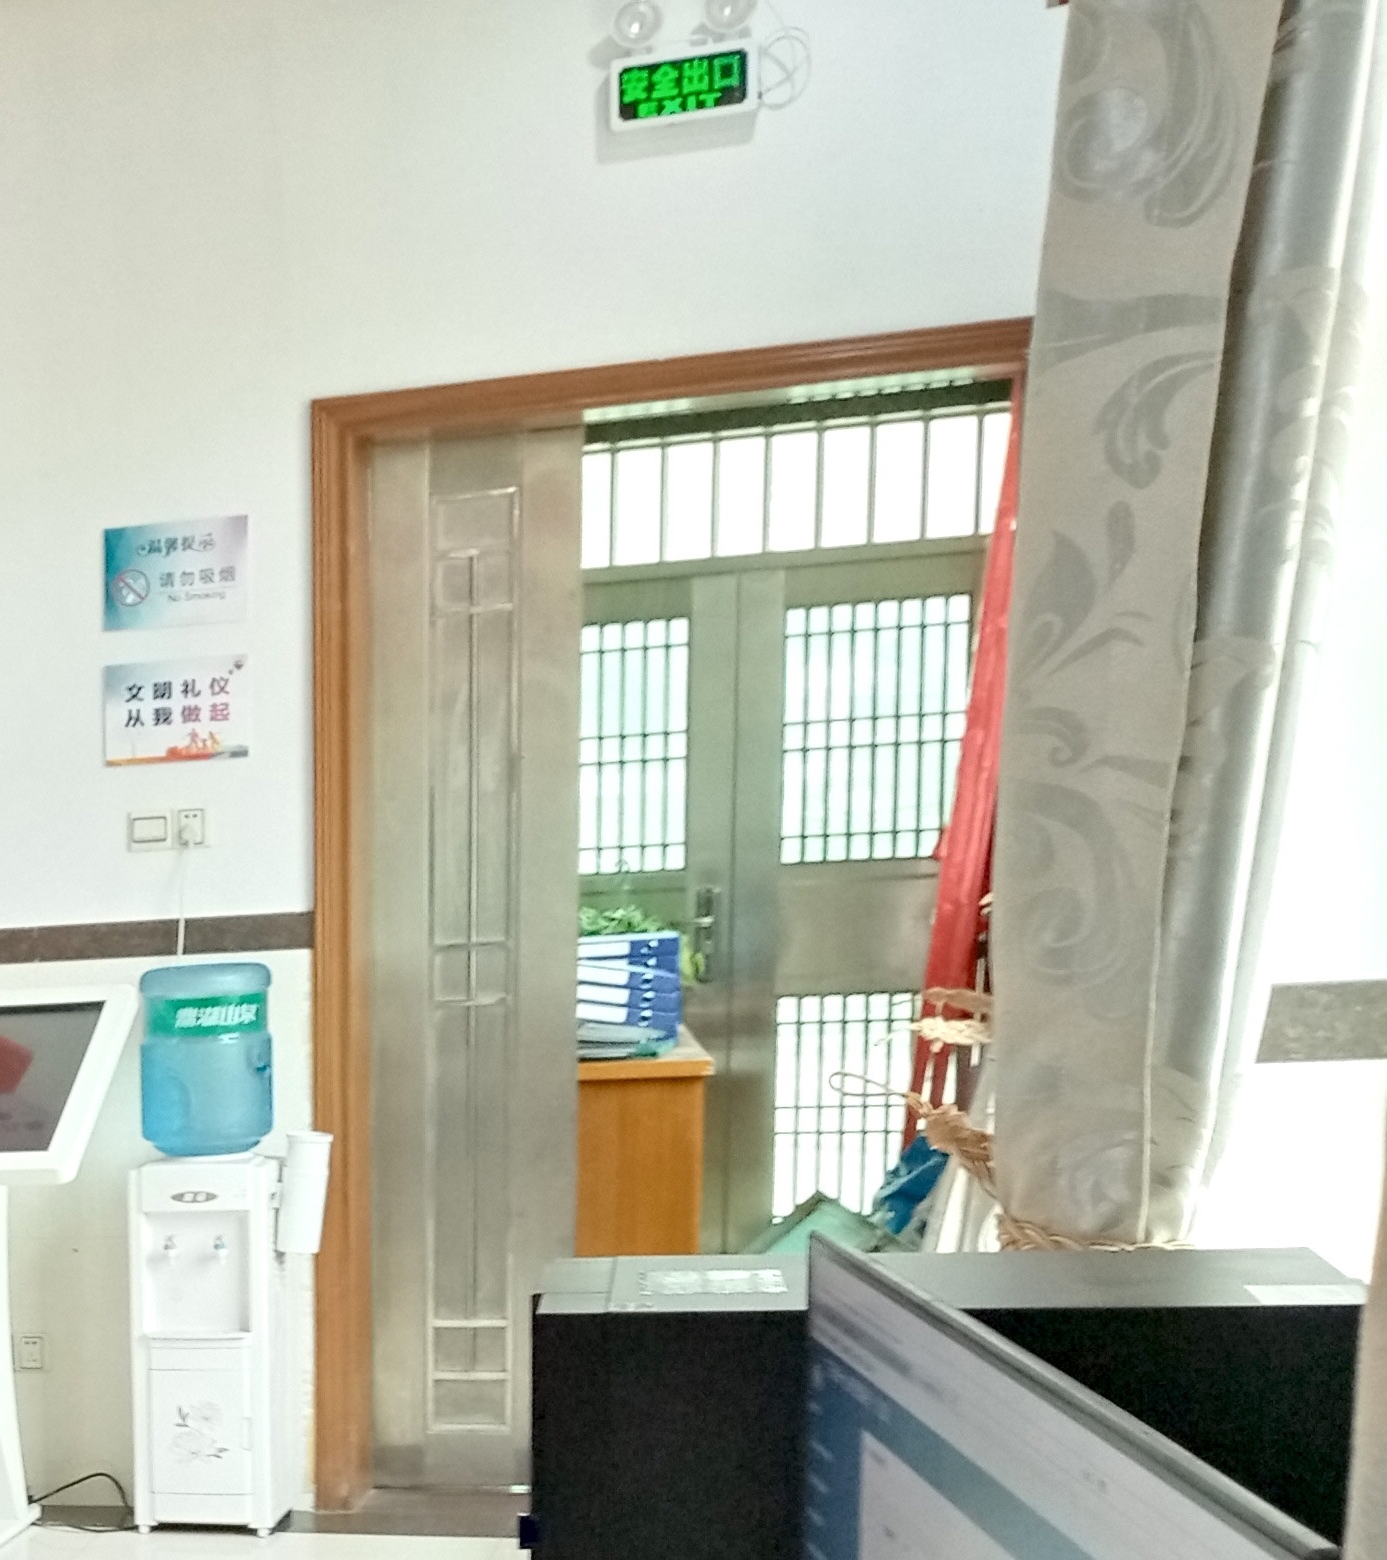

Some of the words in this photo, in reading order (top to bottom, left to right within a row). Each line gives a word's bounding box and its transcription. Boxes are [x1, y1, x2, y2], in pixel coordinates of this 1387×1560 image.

[621, 54, 740, 104] 安全出口
[637, 92, 722, 118] EXIT
[147, 534, 215, 556] 温馨提示
[159, 566, 236, 589] 请勿吸烟
[185, 590, 226, 603] Smoking
[125, 677, 230, 702] 文明礼仪
[125, 703, 230, 728] 从我做起
